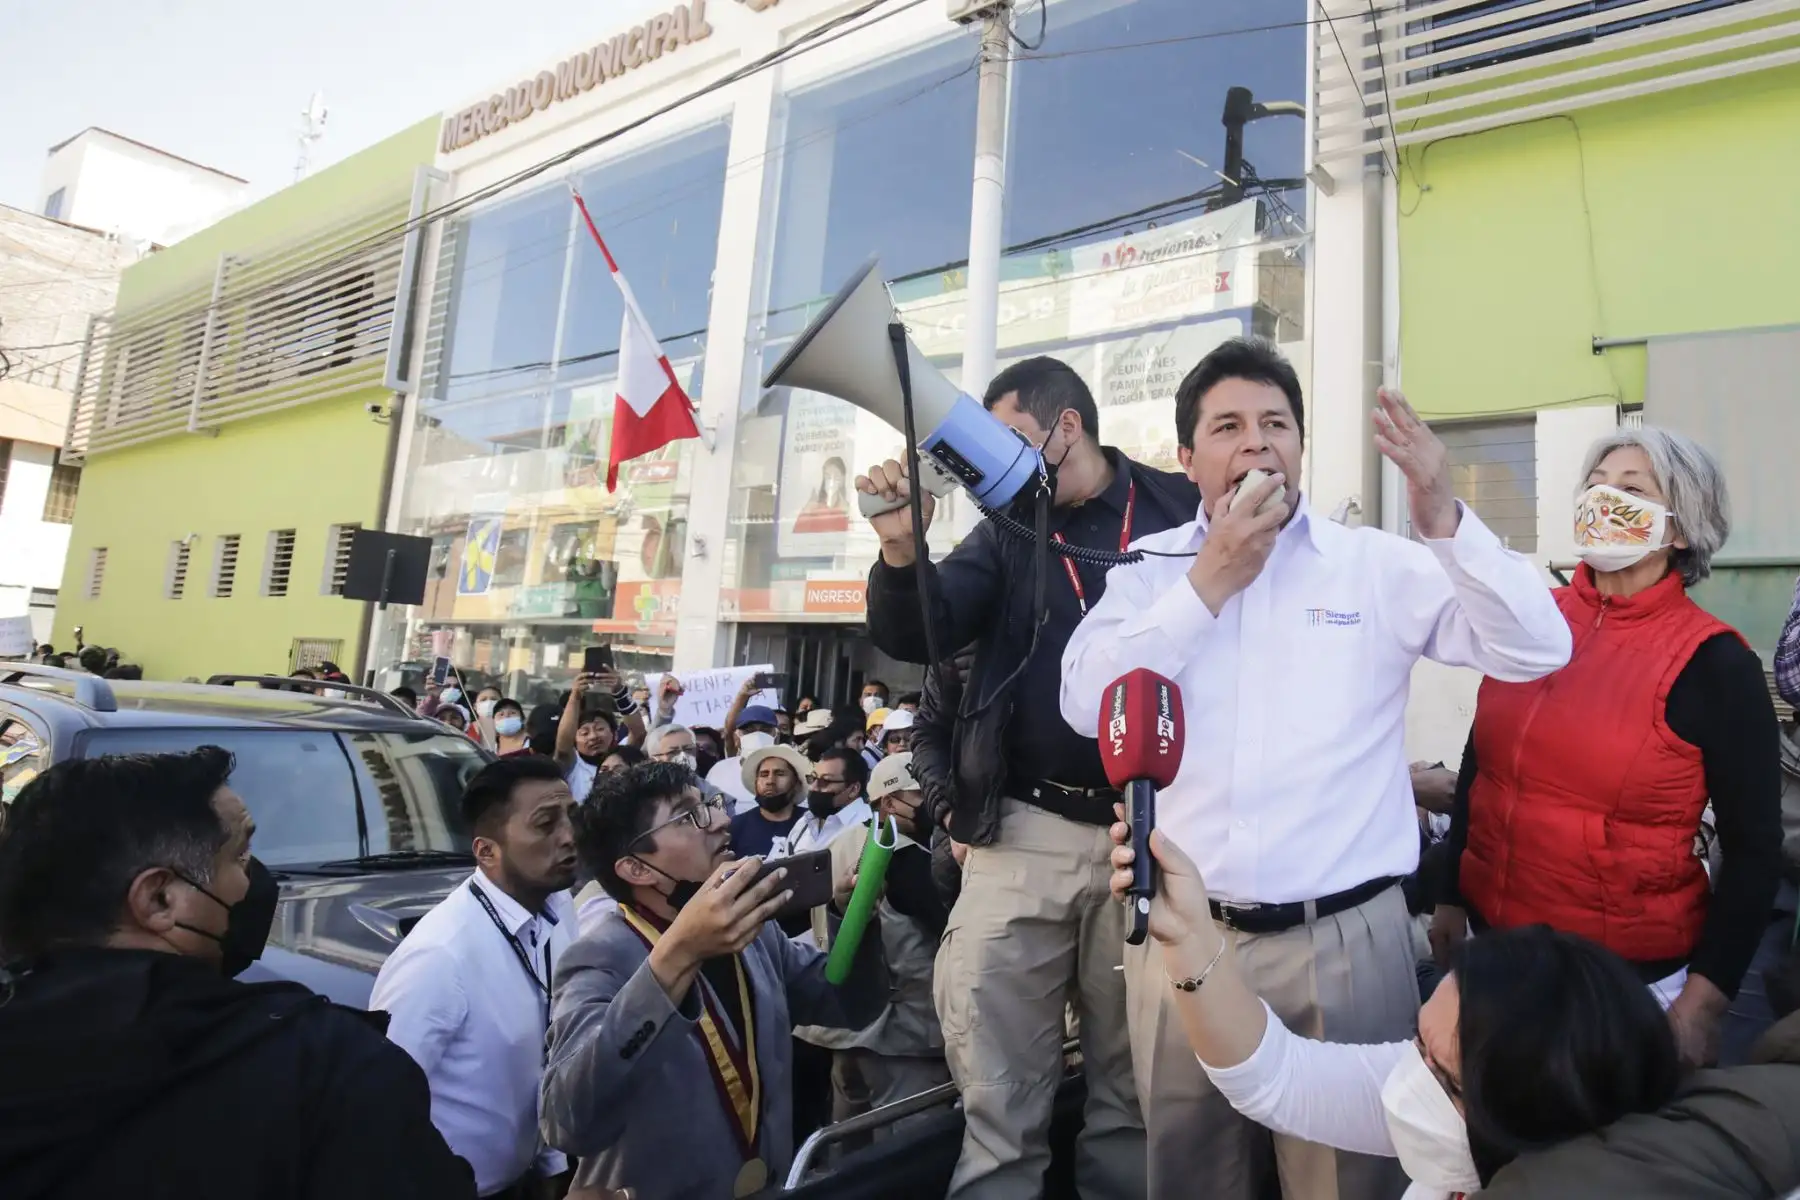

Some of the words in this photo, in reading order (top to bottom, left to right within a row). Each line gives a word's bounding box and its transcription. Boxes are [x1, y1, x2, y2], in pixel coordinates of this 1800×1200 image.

[440, 70, 555, 154] MERCADO
[554, 0, 713, 103] MUNICIPAL
[936, 297, 1055, 335] COD-19
[1112, 356, 1177, 376] REUNINES
[806, 588, 862, 603] INGRESO
